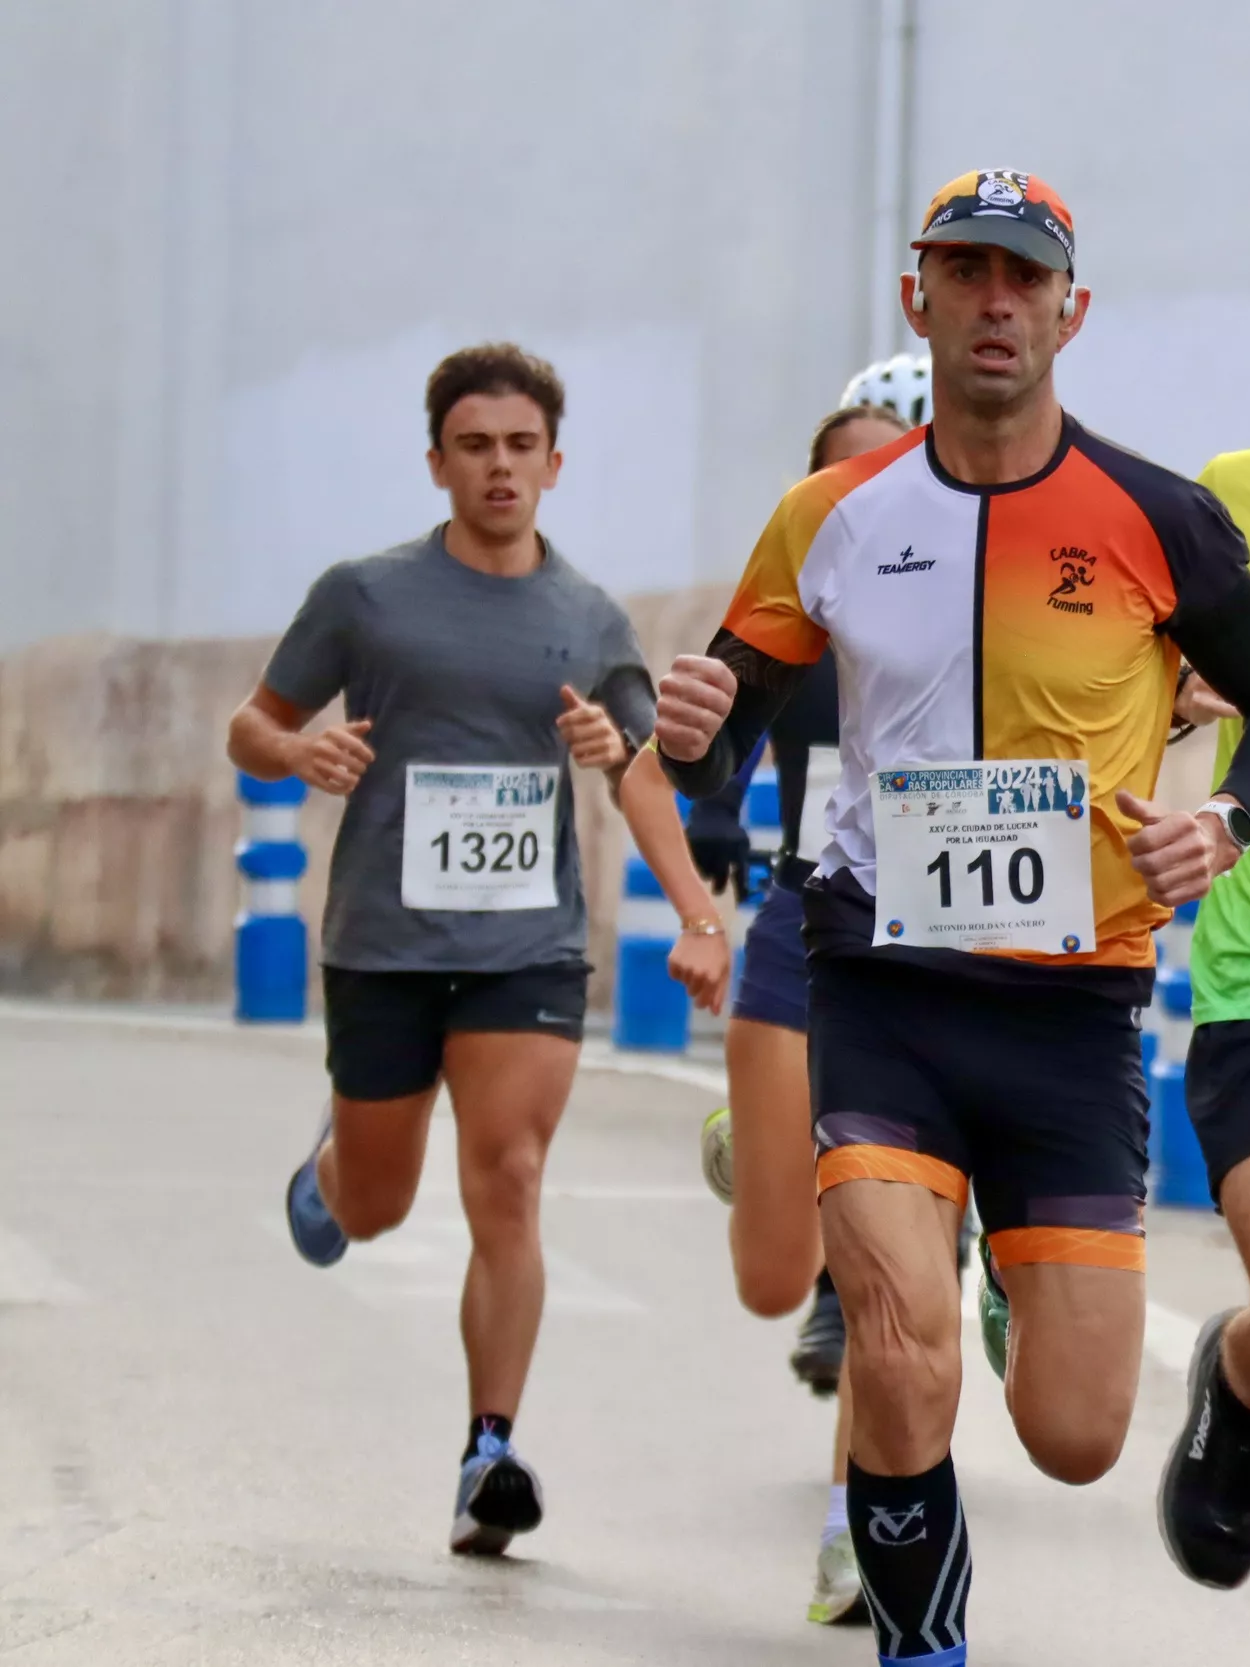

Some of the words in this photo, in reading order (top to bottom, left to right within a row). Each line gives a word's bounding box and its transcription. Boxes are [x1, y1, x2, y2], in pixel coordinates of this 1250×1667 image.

[1050, 547, 1097, 567] CABRA
[877, 560, 936, 575] TEAMERGY
[1047, 597, 1093, 615] running
[919, 769, 969, 781] PROVINCIAL
[972, 769, 983, 778] DE
[984, 766, 1043, 789] 2024
[929, 780, 983, 790] POPULARES
[929, 824, 945, 833] XXV
[962, 823, 992, 832] CIUDAD
[1006, 822, 1038, 830] LUCENA
[976, 834, 1018, 843] IGUALDAD
[431, 831, 539, 874] 1320
[927, 847, 1044, 908] 110
[928, 923, 966, 932] ANTONIO
[1008, 919, 1046, 928] CAÑERO
